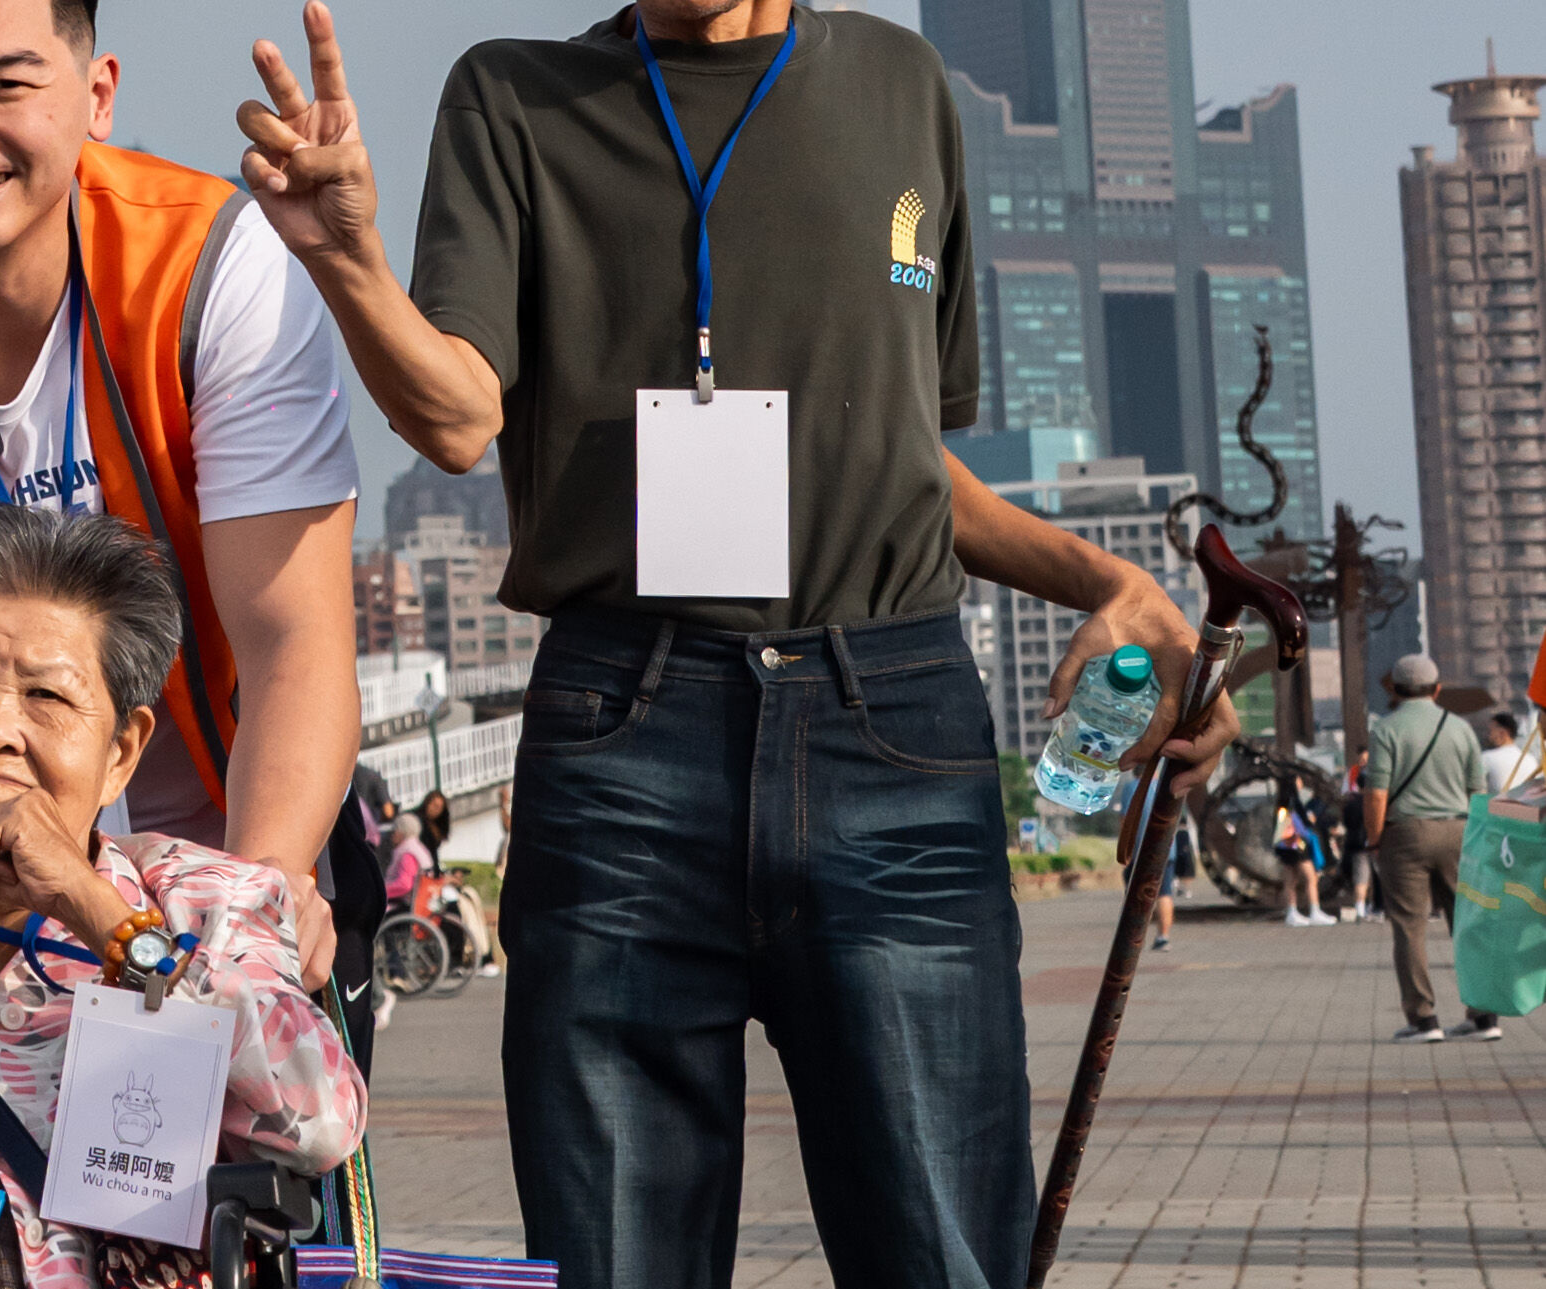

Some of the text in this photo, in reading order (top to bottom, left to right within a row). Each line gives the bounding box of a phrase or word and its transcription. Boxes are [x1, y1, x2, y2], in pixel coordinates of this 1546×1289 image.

[890, 262, 933, 294] 2001
[85, 1146, 176, 1184] 吳綢阿嬤
[141, 1186, 149, 1197] a
[152, 1188, 172, 1201] ma
